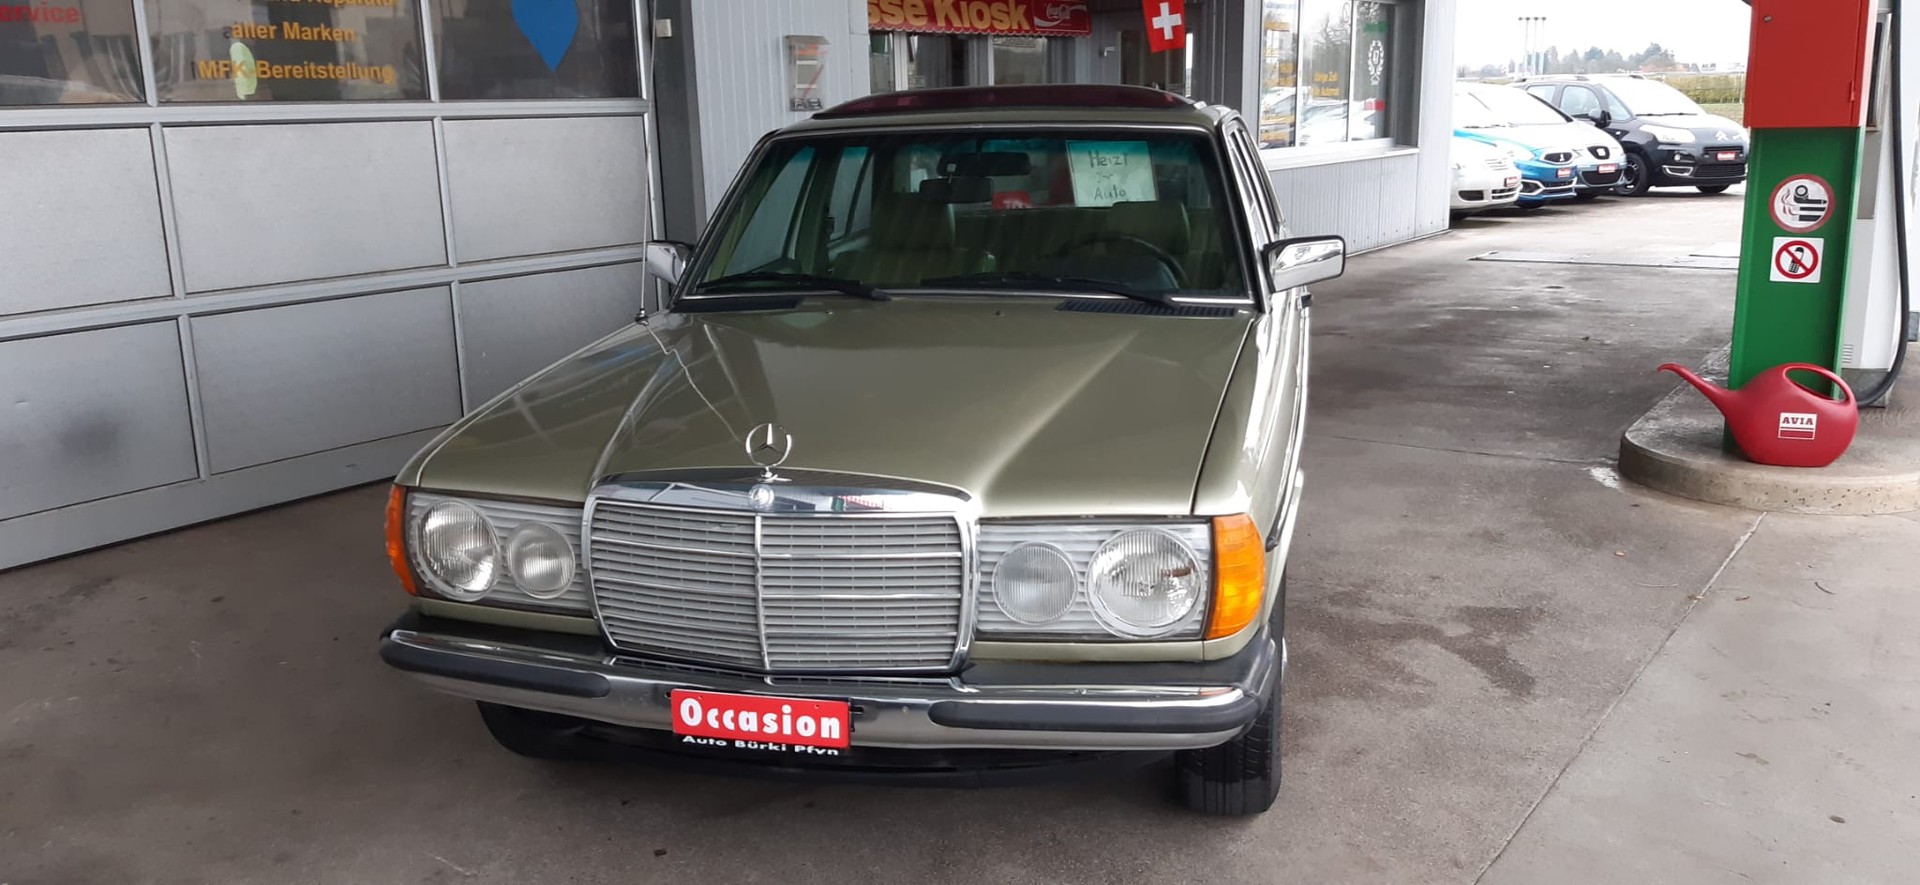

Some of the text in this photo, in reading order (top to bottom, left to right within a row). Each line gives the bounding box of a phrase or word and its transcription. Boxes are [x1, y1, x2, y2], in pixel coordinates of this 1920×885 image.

[231, 22, 356, 42] aller Marken
[1782, 416, 1813, 425] AVIA
[680, 698, 840, 739] Occasion
[682, 735, 728, 746] Auto
[734, 740, 787, 752] Bürki
